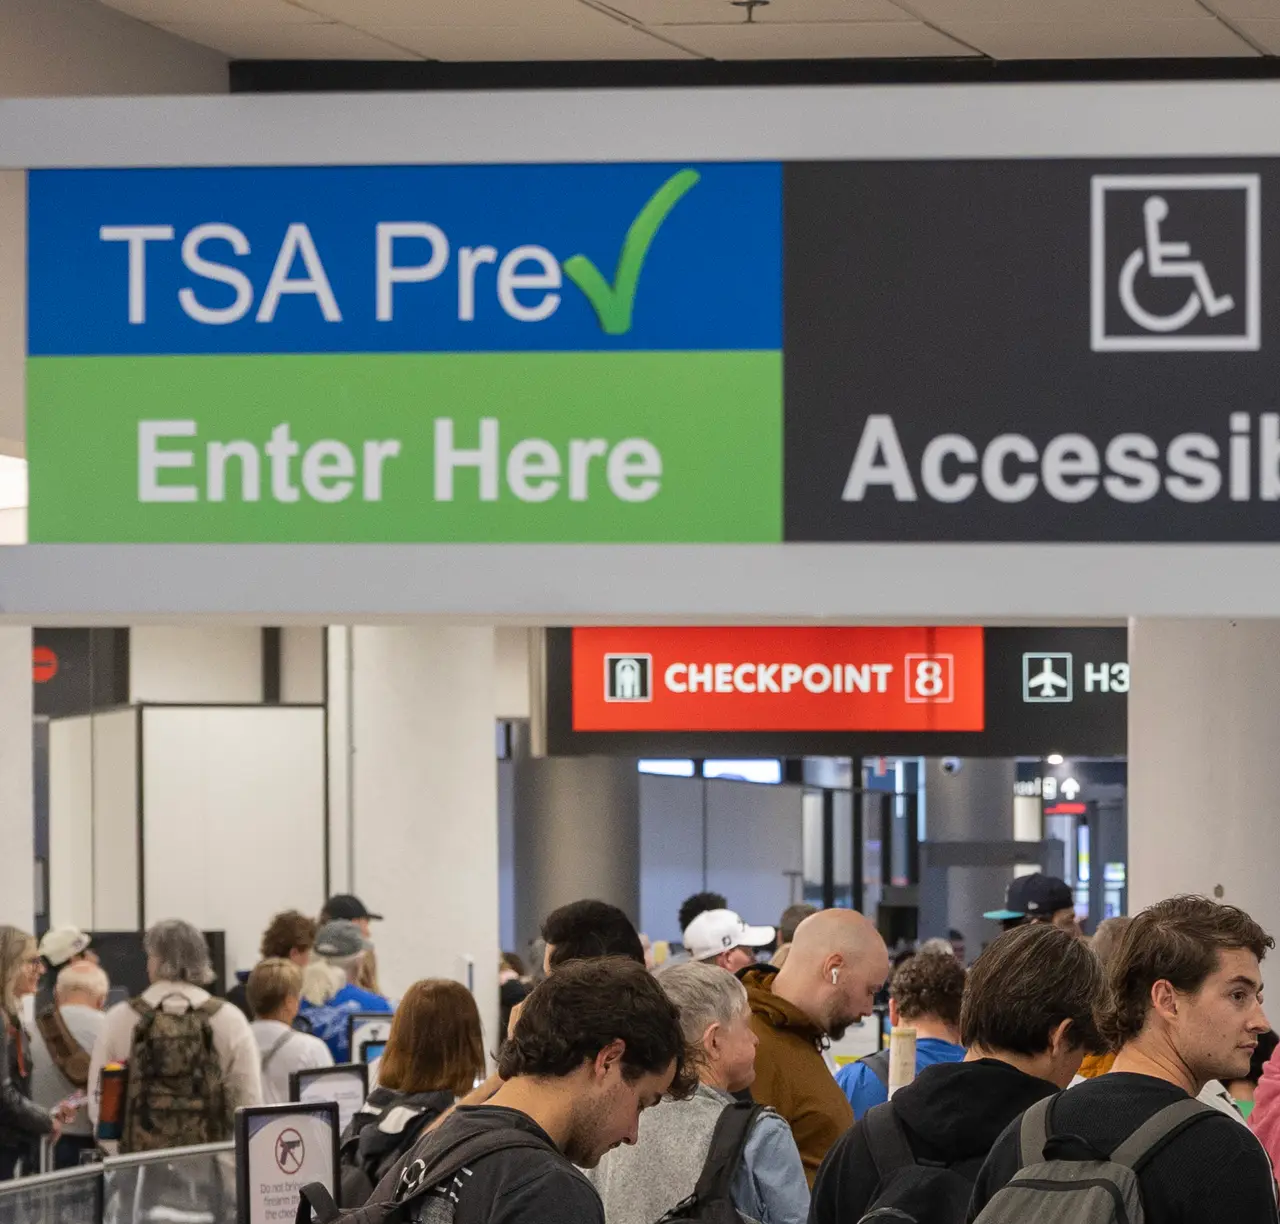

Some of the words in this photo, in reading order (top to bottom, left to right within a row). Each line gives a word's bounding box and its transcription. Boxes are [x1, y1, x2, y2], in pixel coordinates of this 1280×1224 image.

[99, 222, 343, 325] TSA
[375, 221, 563, 322] Pre
[137, 418, 401, 503] Enter
[433, 416, 663, 503] Here
[664, 662, 894, 694] CHECKPOINT
[914, 660, 943, 697] 8
